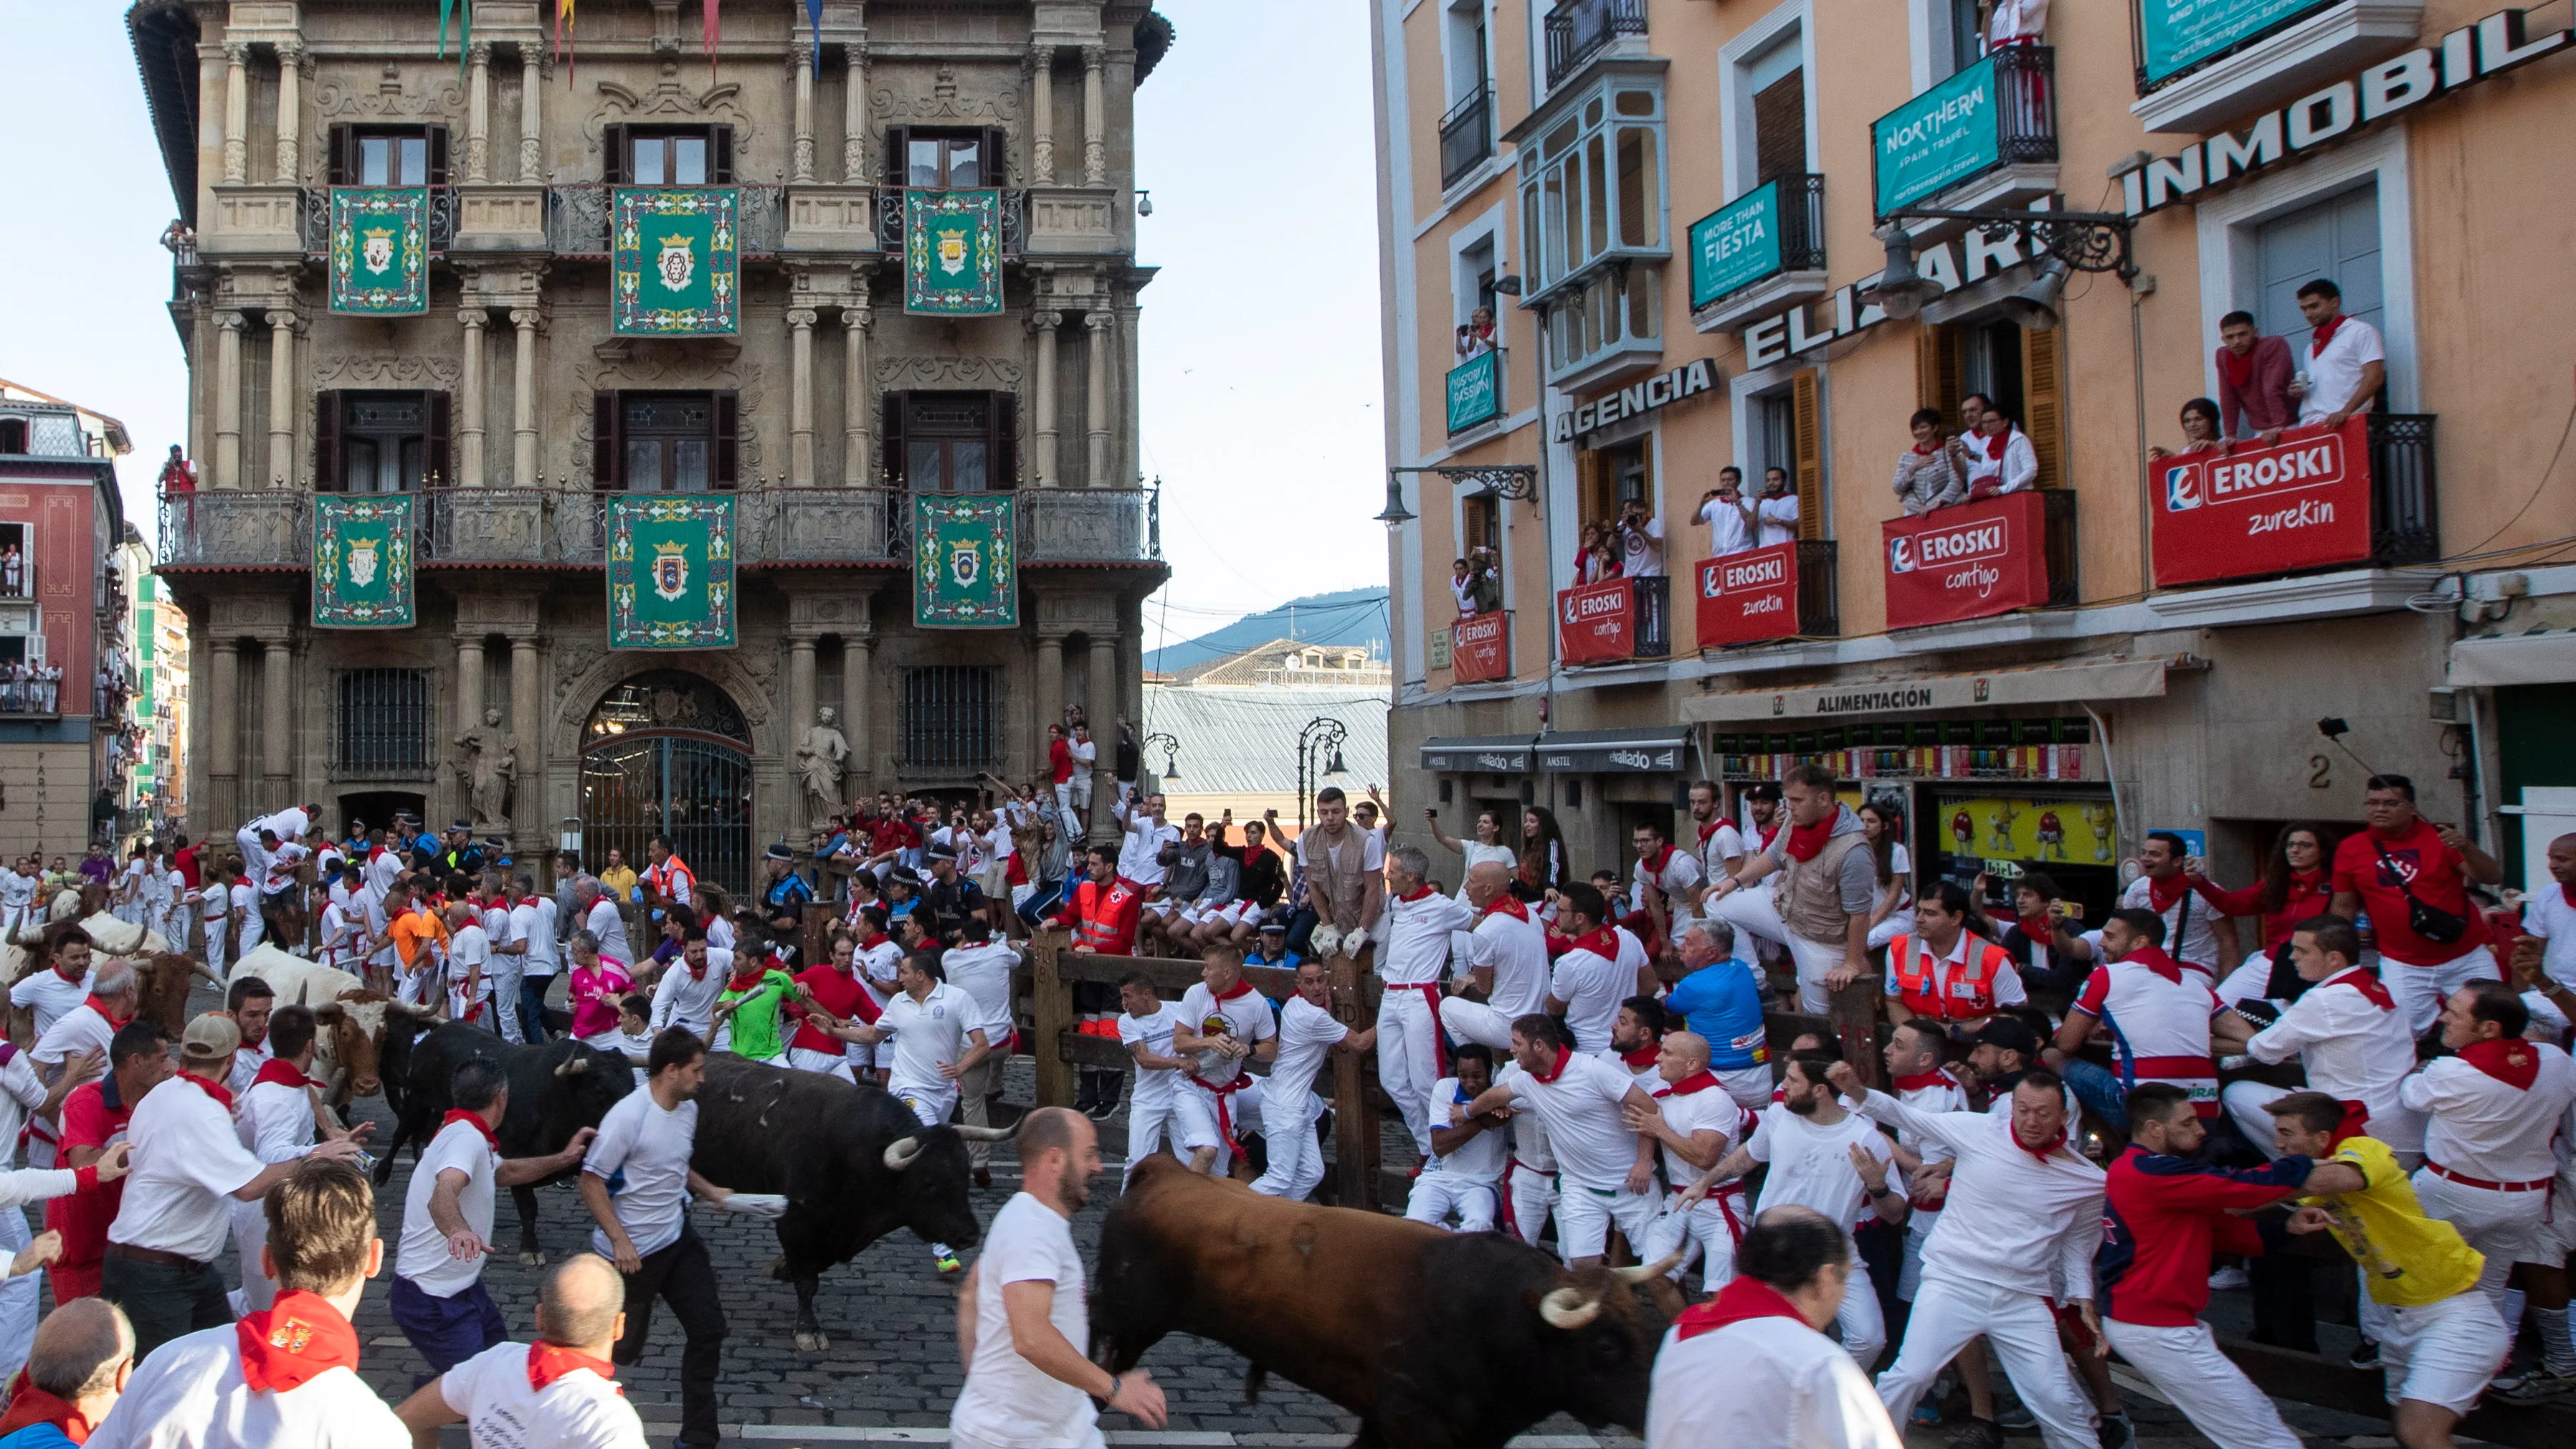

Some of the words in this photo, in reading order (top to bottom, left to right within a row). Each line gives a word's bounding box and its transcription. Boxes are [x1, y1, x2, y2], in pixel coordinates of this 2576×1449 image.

[1887, 85, 1984, 154] NORTHERN
[1900, 148, 1929, 168] SPAIN
[1932, 126, 1970, 151] TRAVEL
[1703, 216, 1734, 243] MORE
[1735, 200, 1764, 224] THAN
[1705, 219, 1765, 267] FIESTA
[1454, 378, 1489, 405] PASSION
[1554, 359, 1711, 443] AGENCIA
[2214, 445, 2332, 495] EROSKI
[2248, 500, 2334, 536] zurekin
[1921, 526, 2000, 561] EROSKI
[1726, 559, 1782, 588] EROSKI
[1946, 561, 2000, 599] contigo
[1582, 592, 1622, 615] EROSKI
[1743, 594, 1783, 617] zurekin
[1467, 622, 1496, 641] EROSKI
[1594, 618, 1621, 643] contigo
[1476, 644, 1496, 665] contigo
[1816, 685, 1931, 713] ALIMENTACIÓN
[1428, 756, 1446, 766] AMSTEL
[1546, 756, 1570, 766] AMSTEL
[2309, 754, 2330, 788] 2
[37, 752, 46, 852] FARMACIA
